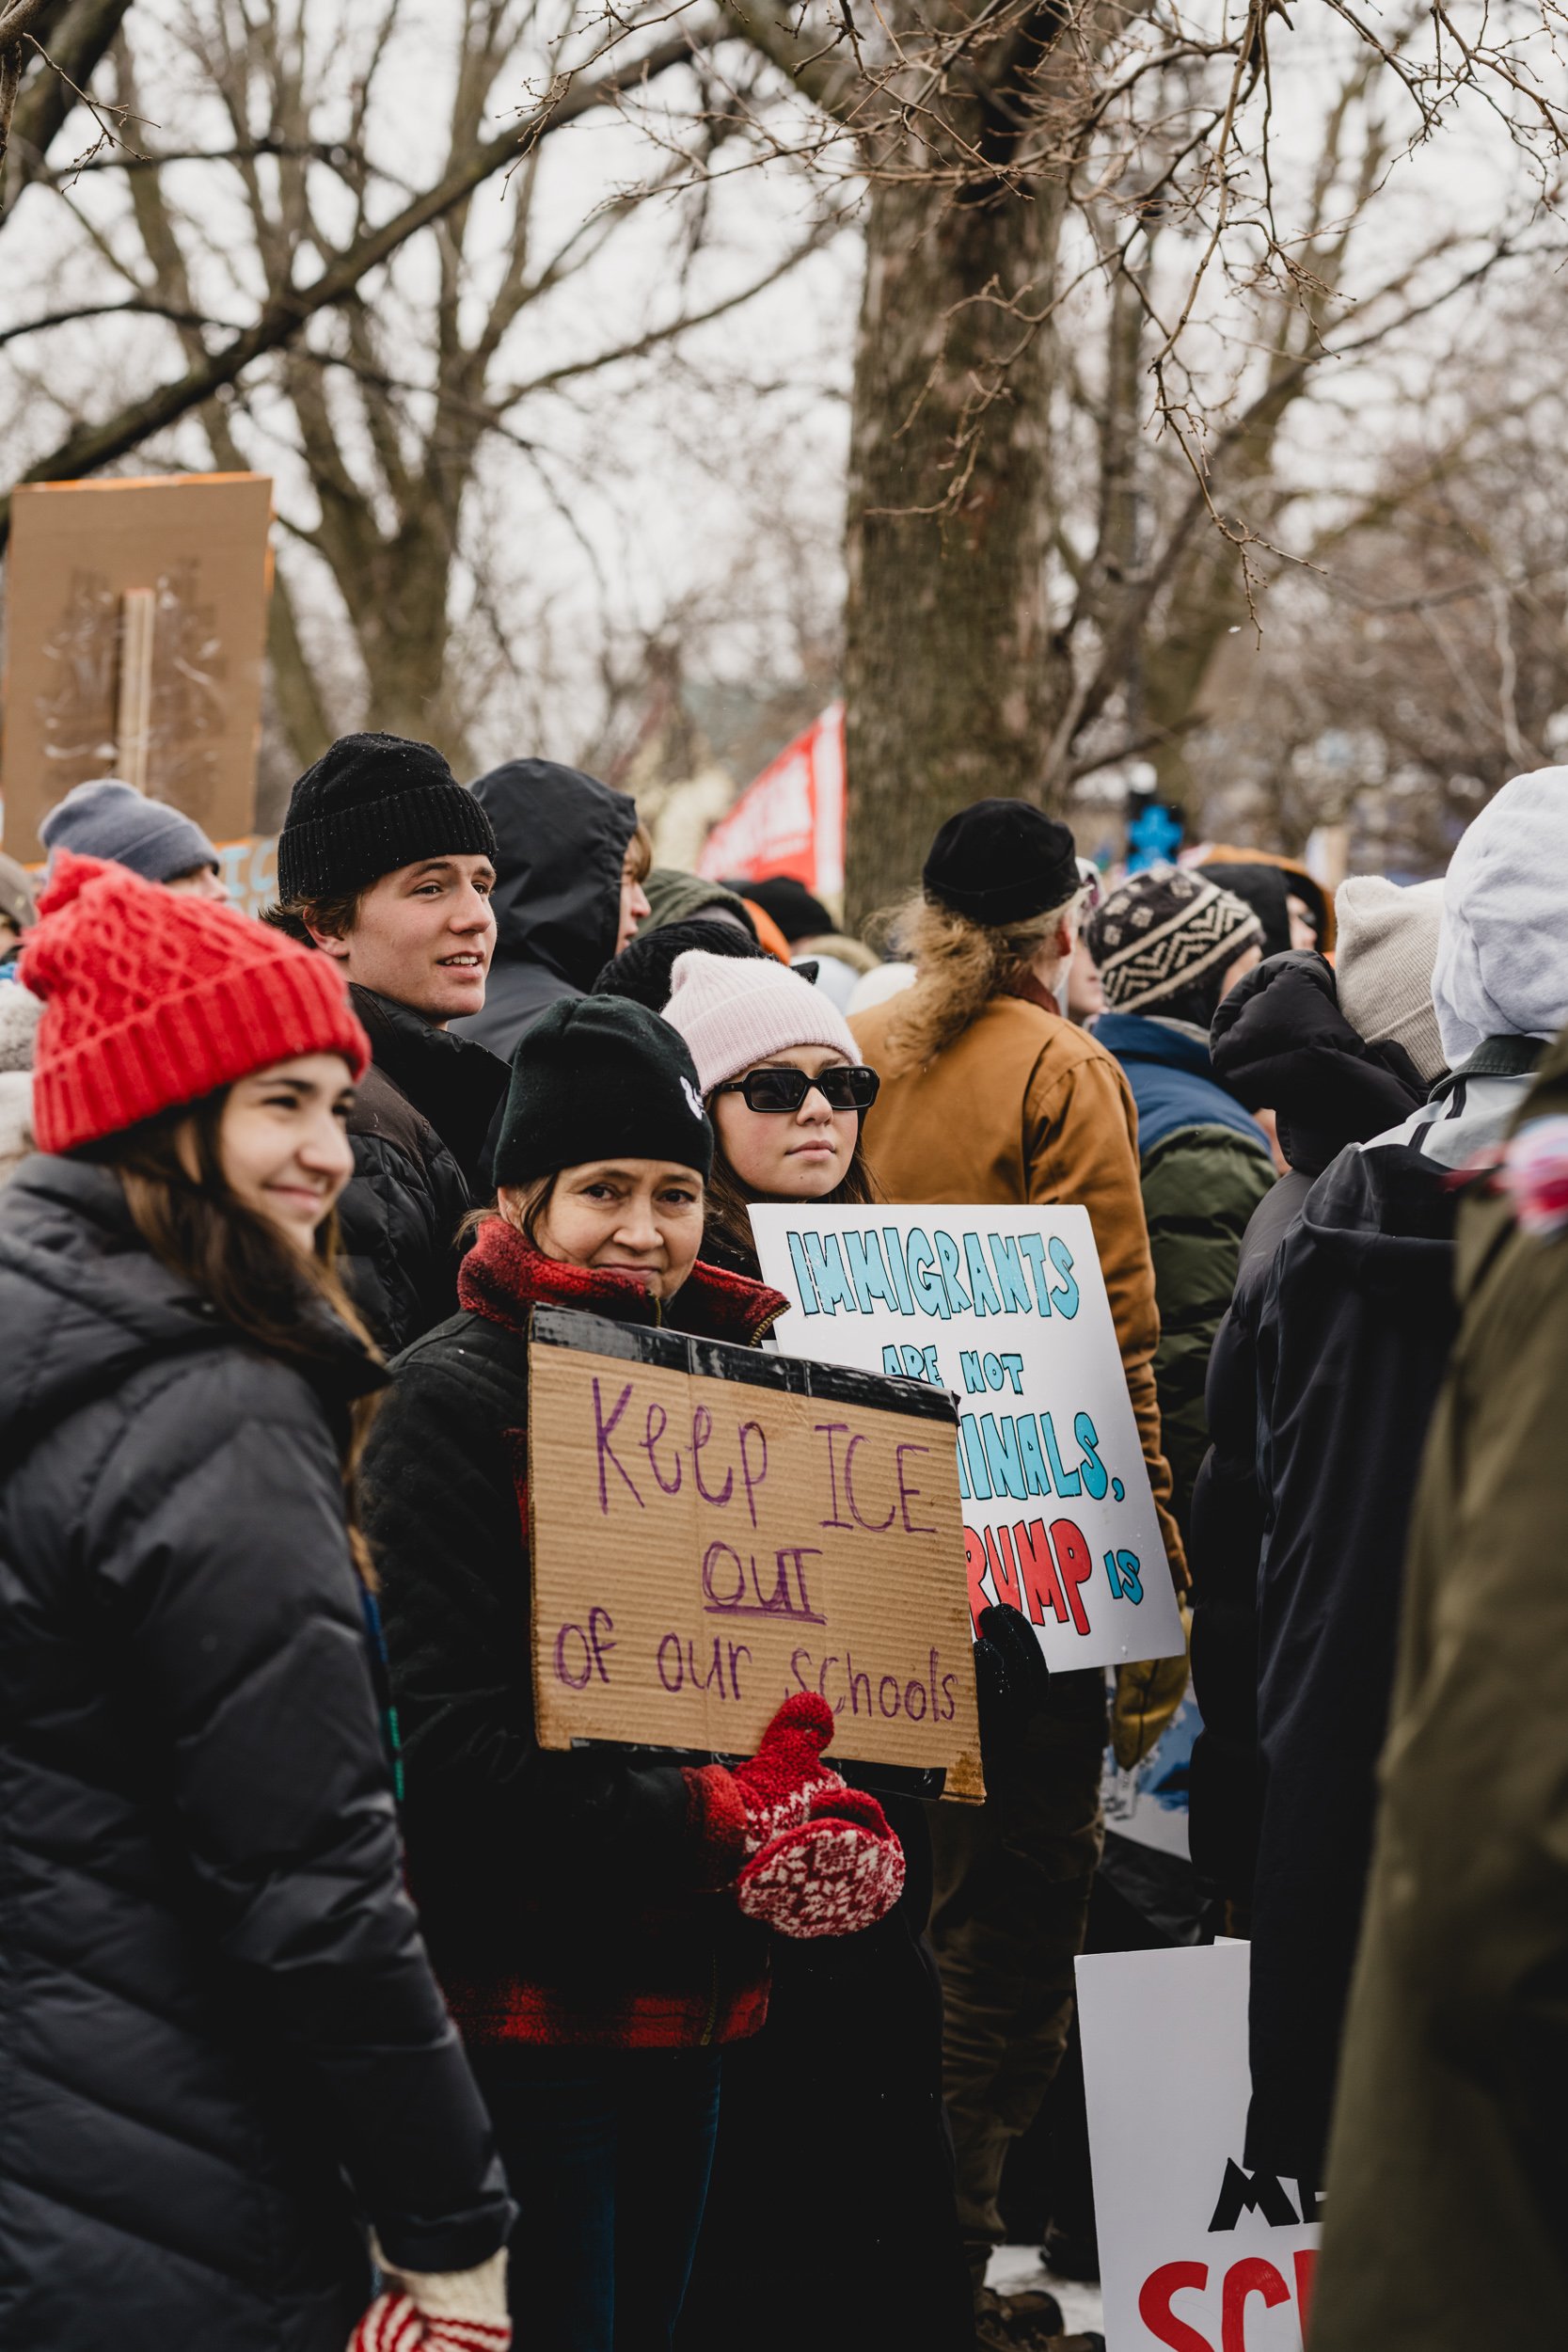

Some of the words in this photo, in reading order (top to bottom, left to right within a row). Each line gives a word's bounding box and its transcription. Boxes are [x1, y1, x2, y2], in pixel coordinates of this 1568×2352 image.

[785, 1227, 1081, 1320] IMMIGRANTS
[881, 1344, 945, 1389] ARE
[958, 1350, 1024, 1395] NOT
[592, 1376, 768, 1530] Keep
[815, 1423, 939, 1534] ICE
[957, 1411, 1126, 1502] INALS,
[1102, 1548, 1145, 1606] IS
[657, 1632, 752, 1702] our
